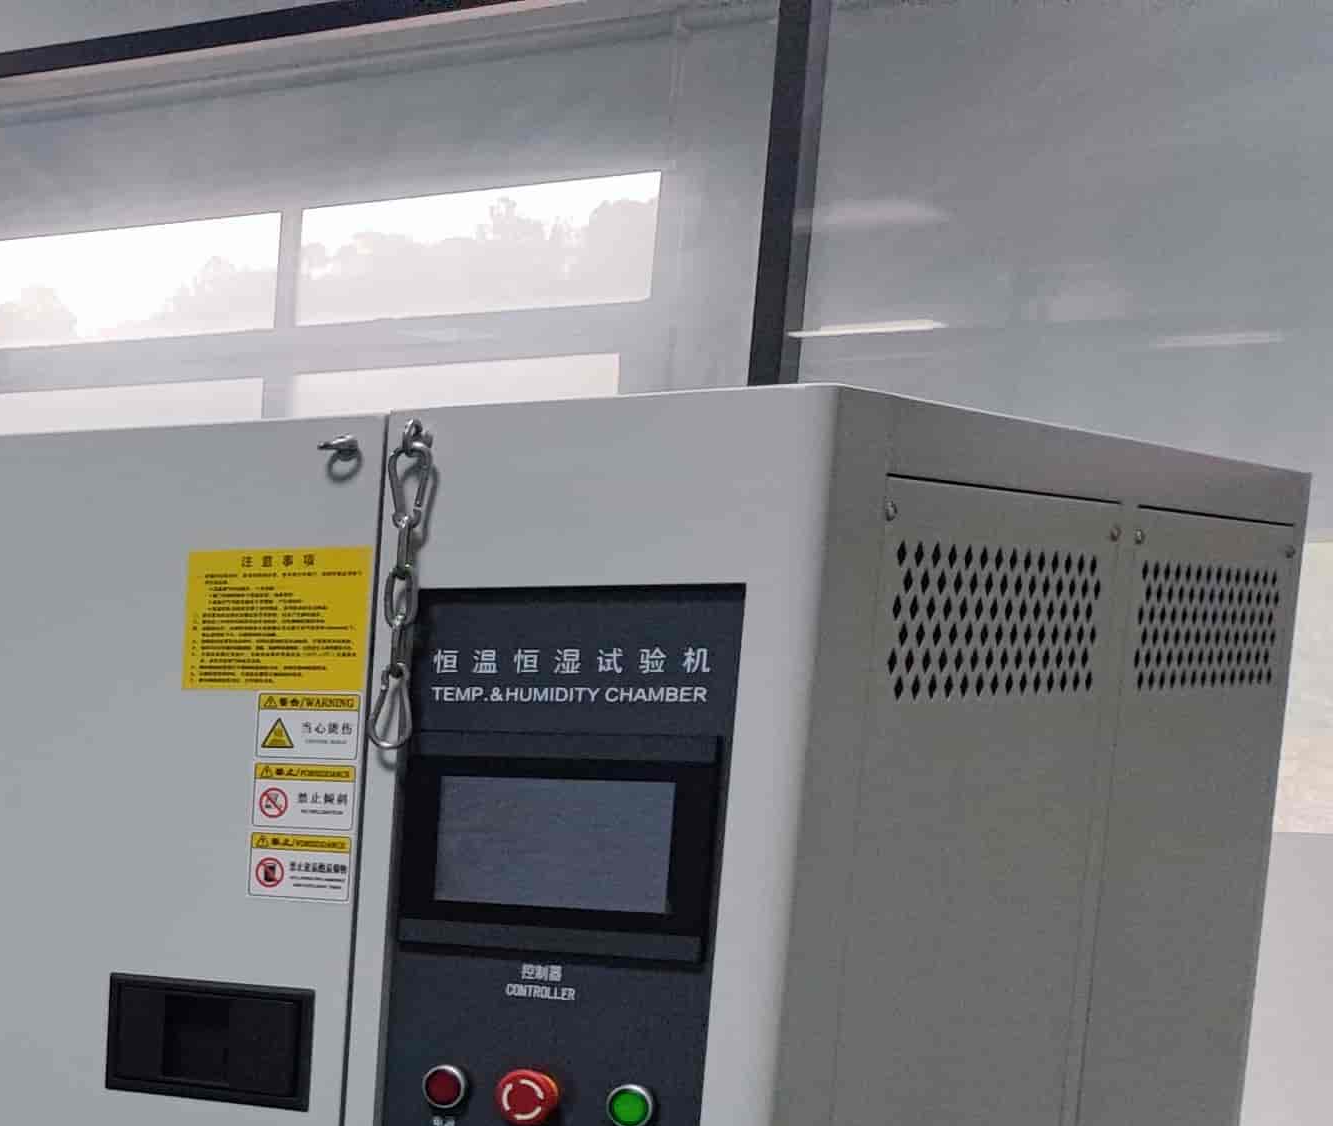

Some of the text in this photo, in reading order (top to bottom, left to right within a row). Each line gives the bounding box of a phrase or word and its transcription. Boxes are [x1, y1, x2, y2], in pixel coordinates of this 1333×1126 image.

[433, 648, 711, 674] 恒温恒湿试验机
[432, 686, 708, 703] TEMP.&HUMIDITY CHAMBER
[522, 963, 562, 982] 控制器
[505, 983, 576, 1001] CONTROLLER
